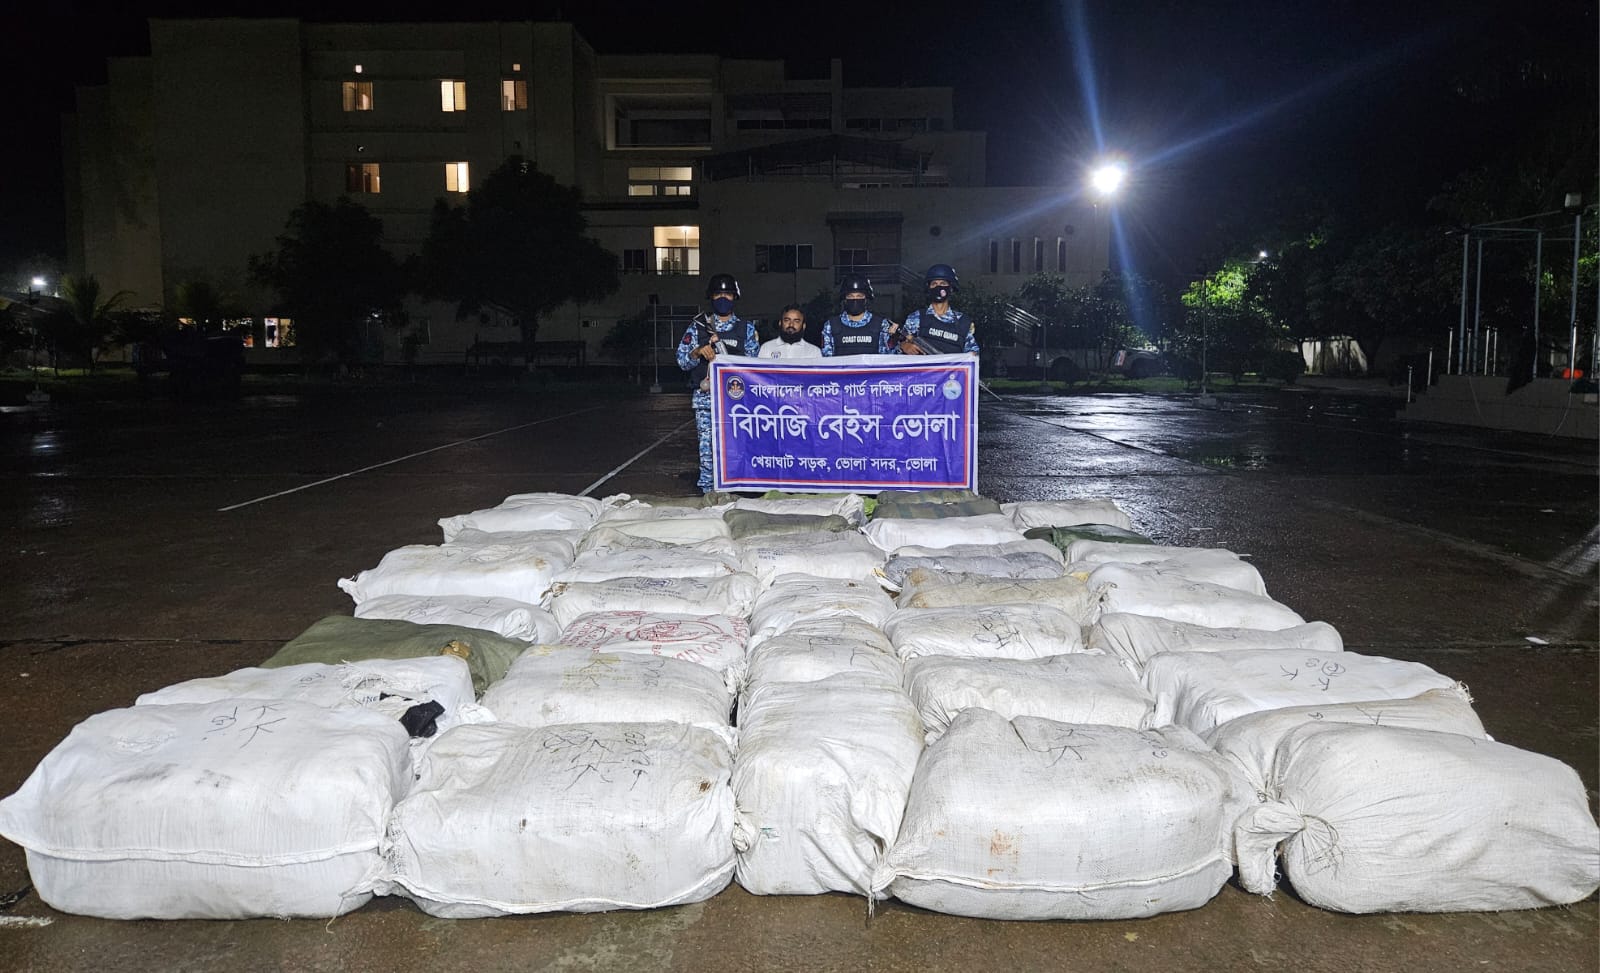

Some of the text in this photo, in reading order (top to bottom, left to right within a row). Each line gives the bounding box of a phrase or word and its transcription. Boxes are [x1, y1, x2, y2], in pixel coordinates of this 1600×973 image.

[857, 335, 872, 343] GUARD
[929, 328, 959, 341] COAST GUARD
[749, 383, 803, 399] বাংলাদেশ
[807, 381, 841, 398] কোস্ট
[844, 380, 868, 397] গার্ড
[870, 380, 904, 397] দক্ষিণ
[907, 383, 937, 397] জোন
[728, 404, 961, 444] বিসিজি বেইস ভোলা
[751, 454, 938, 473] খেয়াঘাট সড়ক, ভোলা সদর, ভোলা
